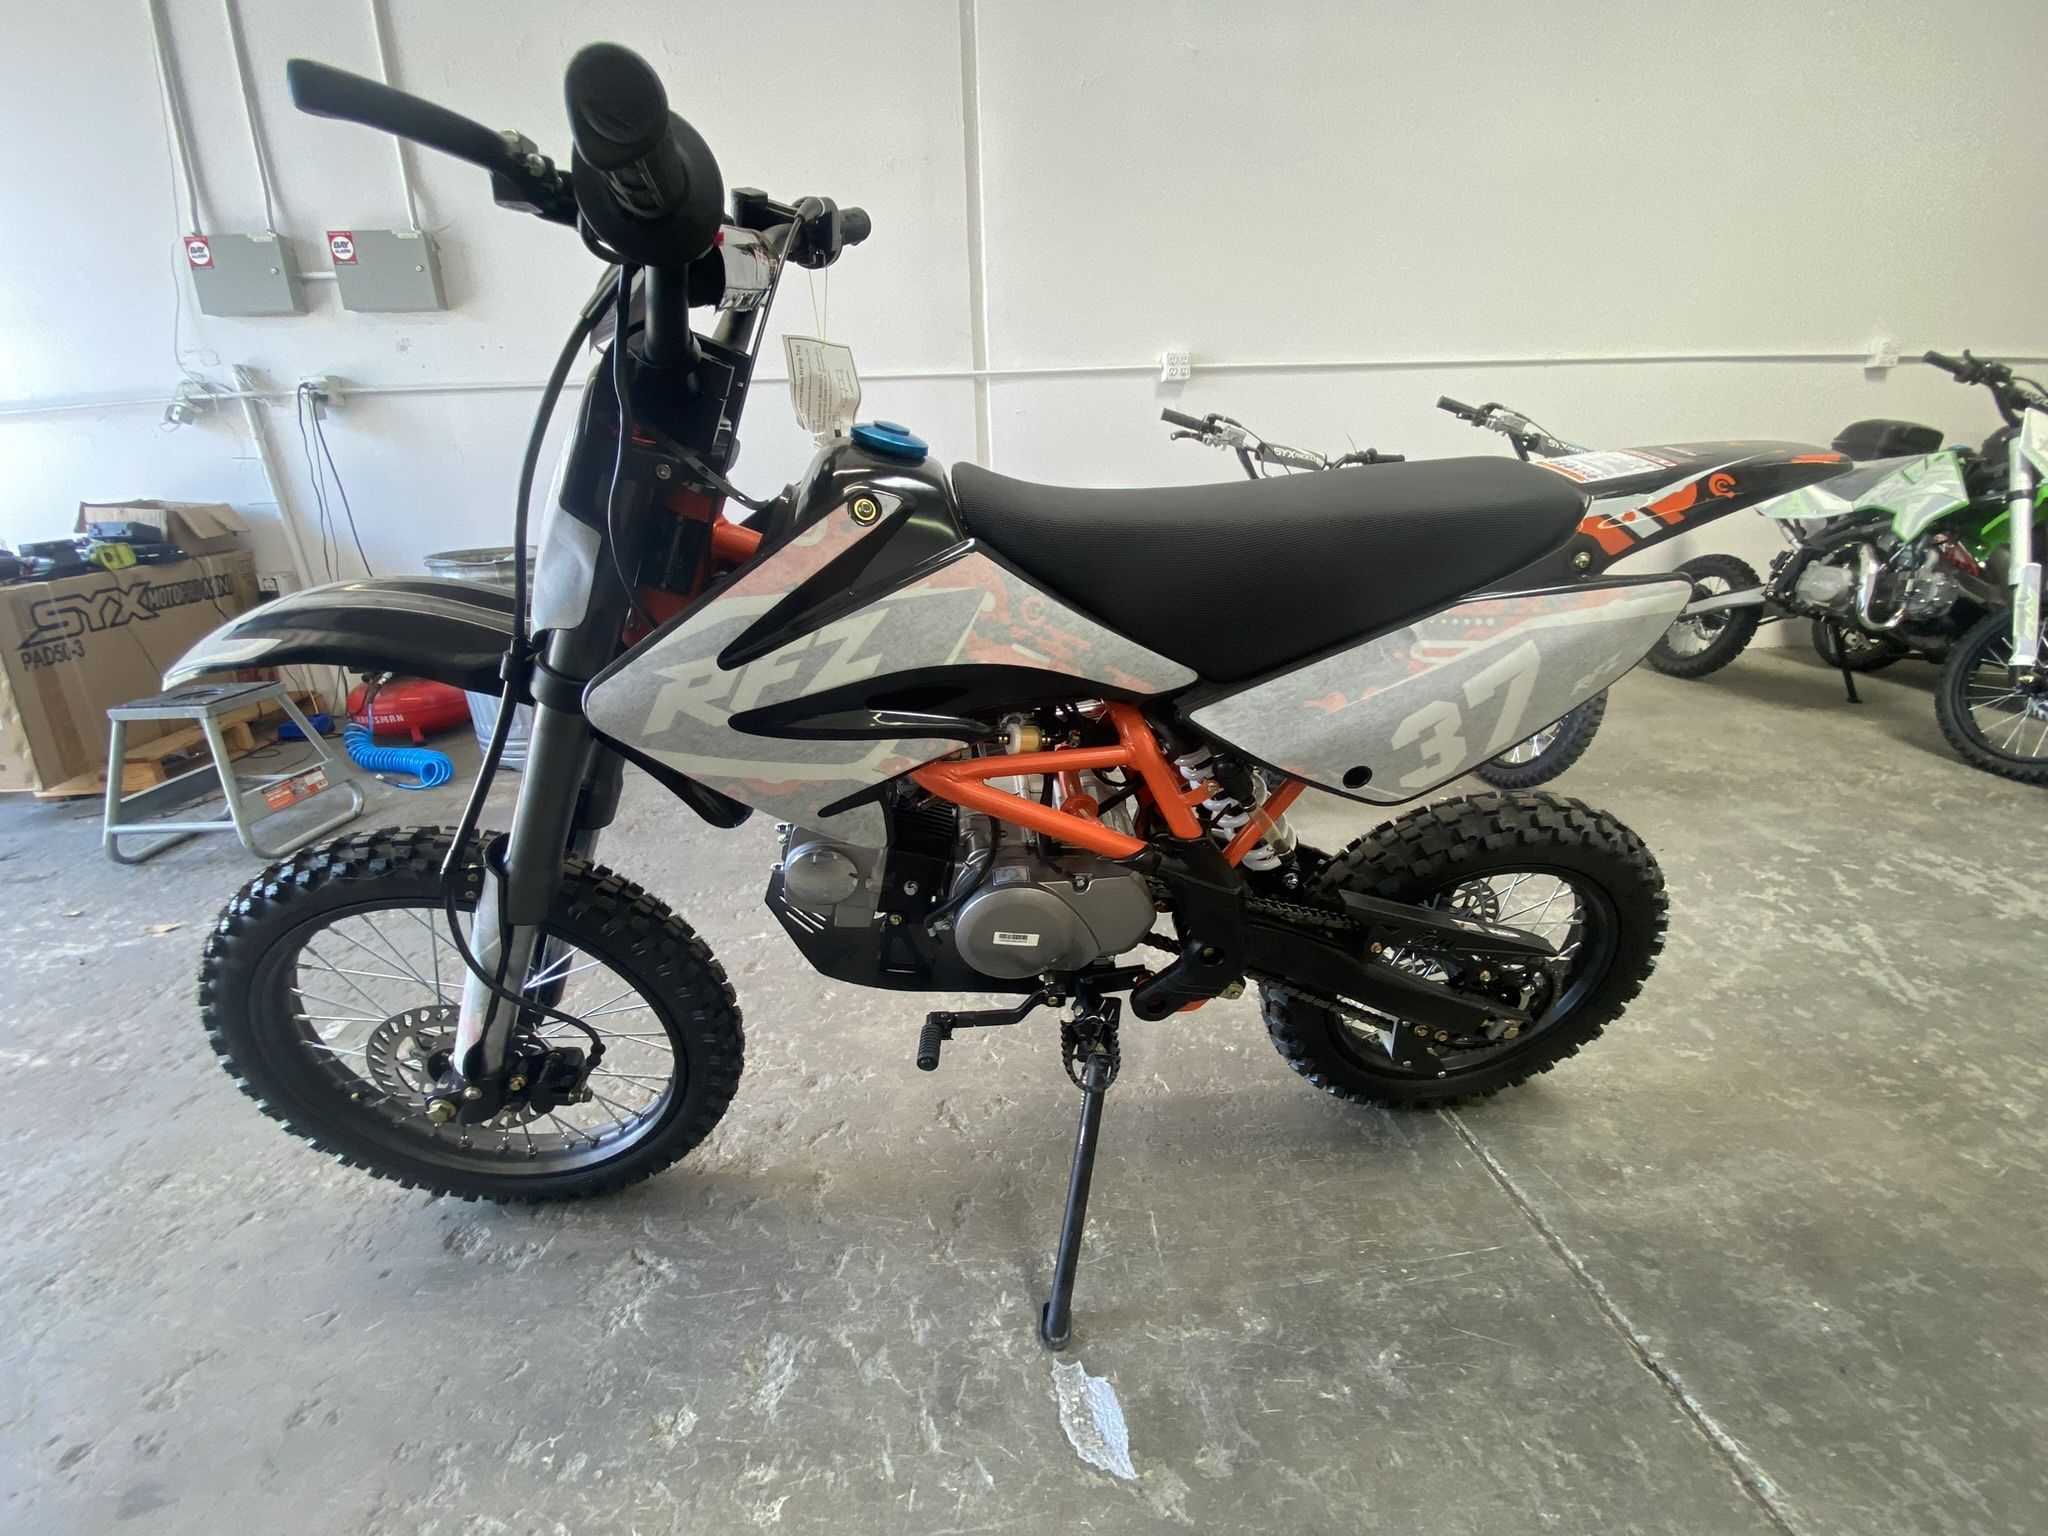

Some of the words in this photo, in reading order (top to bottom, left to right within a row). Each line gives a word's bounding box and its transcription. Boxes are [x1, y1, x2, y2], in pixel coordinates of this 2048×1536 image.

[1273, 447, 1296, 459] SYX
[18, 580, 160, 650] SYX
[642, 606, 892, 736] RFZ
[1391, 639, 1541, 789] 37
